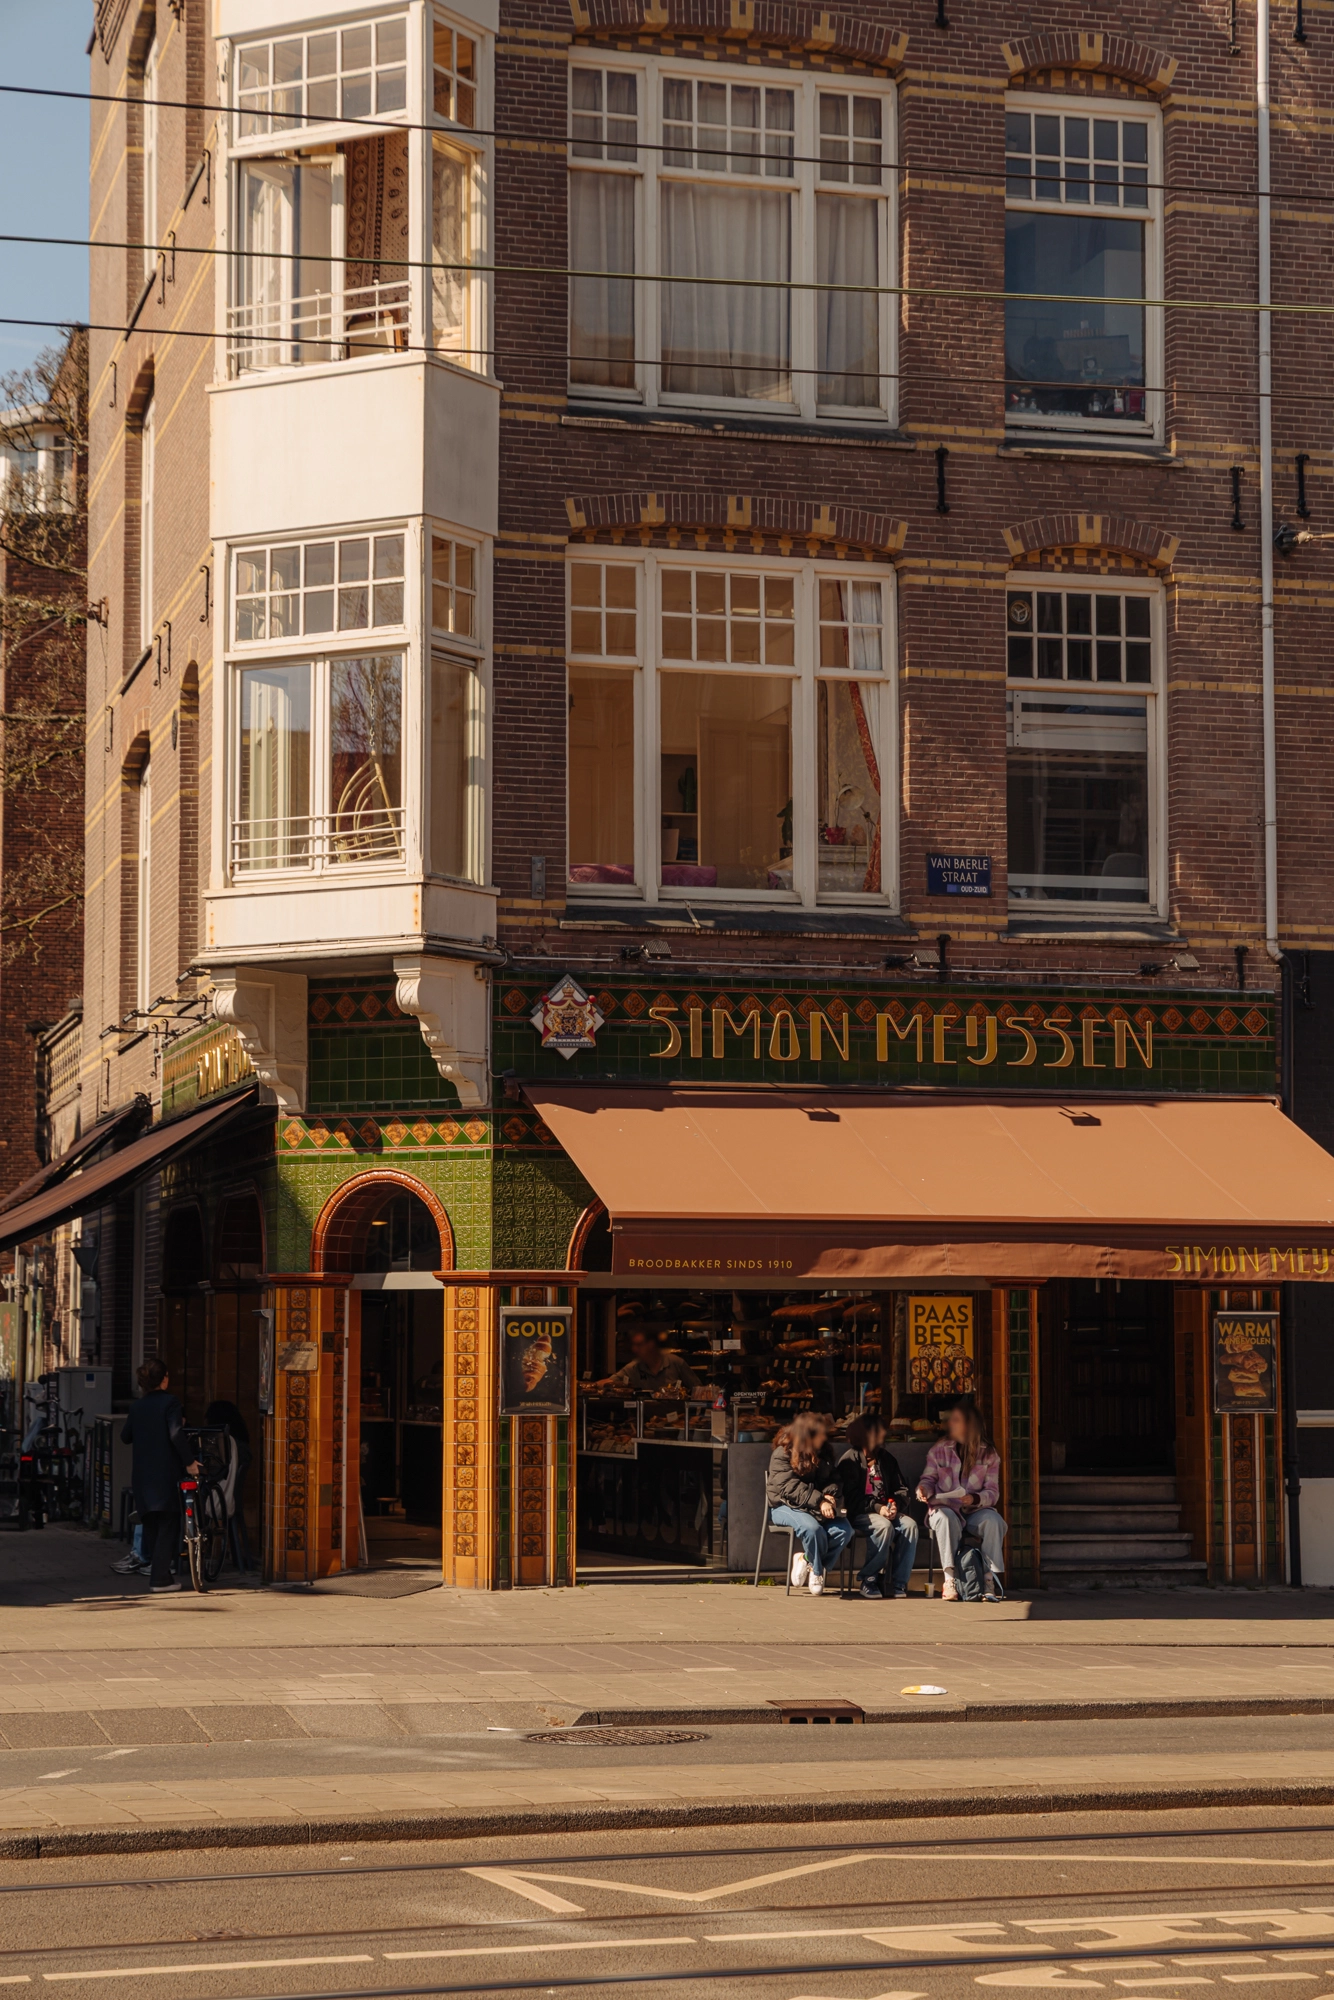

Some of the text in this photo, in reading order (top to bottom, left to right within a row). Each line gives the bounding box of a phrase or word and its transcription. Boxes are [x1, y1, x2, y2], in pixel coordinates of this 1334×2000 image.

[930, 857, 988, 870] VAN BAERLE
[942, 871, 978, 883] STRAAT
[960, 885, 987, 894] OUD-ZUID
[649, 1007, 1153, 1069] SIMON MEIJSSEN
[628, 1258, 793, 1269] BROODBAKKER SINDS 1910
[1165, 1245, 1334, 1275] SIMON MEIJ
[914, 1304, 969, 1324] PAAS
[506, 1321, 565, 1338] GOUD
[914, 1324, 969, 1346] BEST
[1217, 1322, 1271, 1337] WARM
